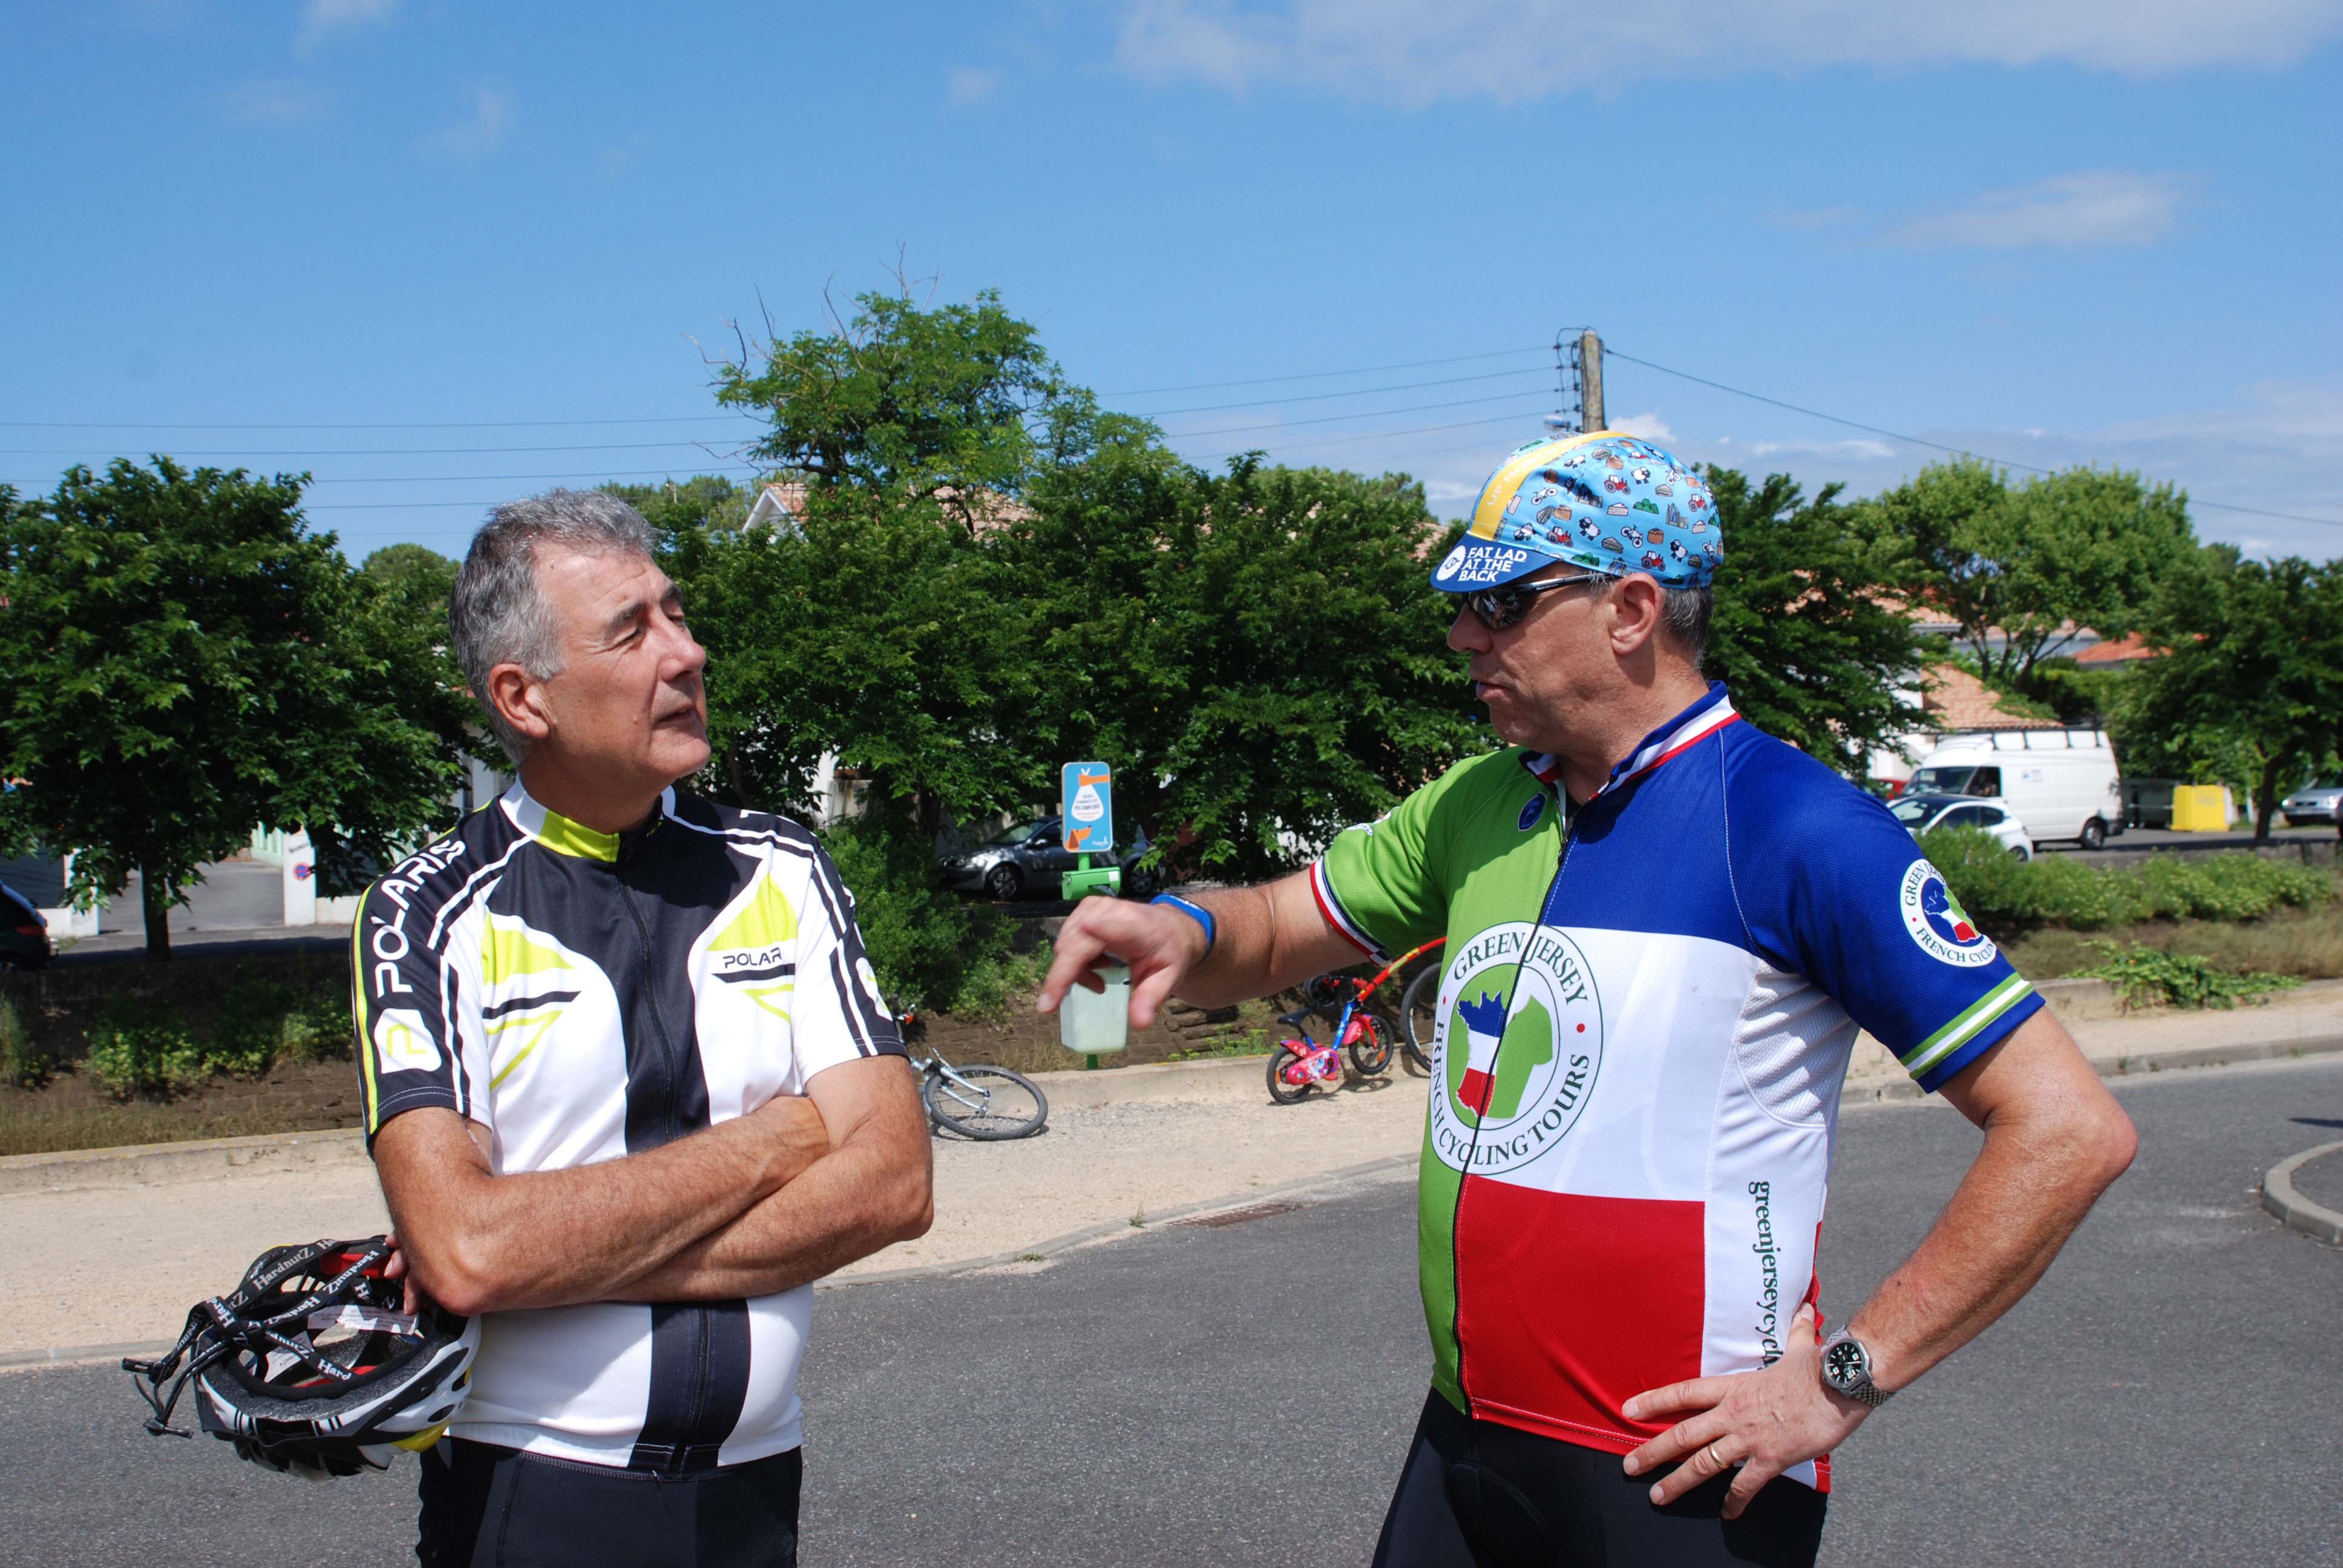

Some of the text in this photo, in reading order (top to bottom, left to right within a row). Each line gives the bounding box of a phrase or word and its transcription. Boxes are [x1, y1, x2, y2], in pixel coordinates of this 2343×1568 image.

[1461, 558, 1514, 572] AT THE
[1467, 547, 1528, 563] FAT LAD
[1457, 570, 1499, 582] BACK
[1906, 864, 1925, 906] GREEN
[371, 839, 465, 998] POLARIS
[723, 947, 782, 969] POLAR
[1916, 927, 1965, 962] FRENCH
[1454, 932, 1588, 1005] GREEN JERSEY
[1433, 1022, 1589, 1165] FRENCH CYCLING TOURS
[253, 1247, 315, 1292] HardnutZ
